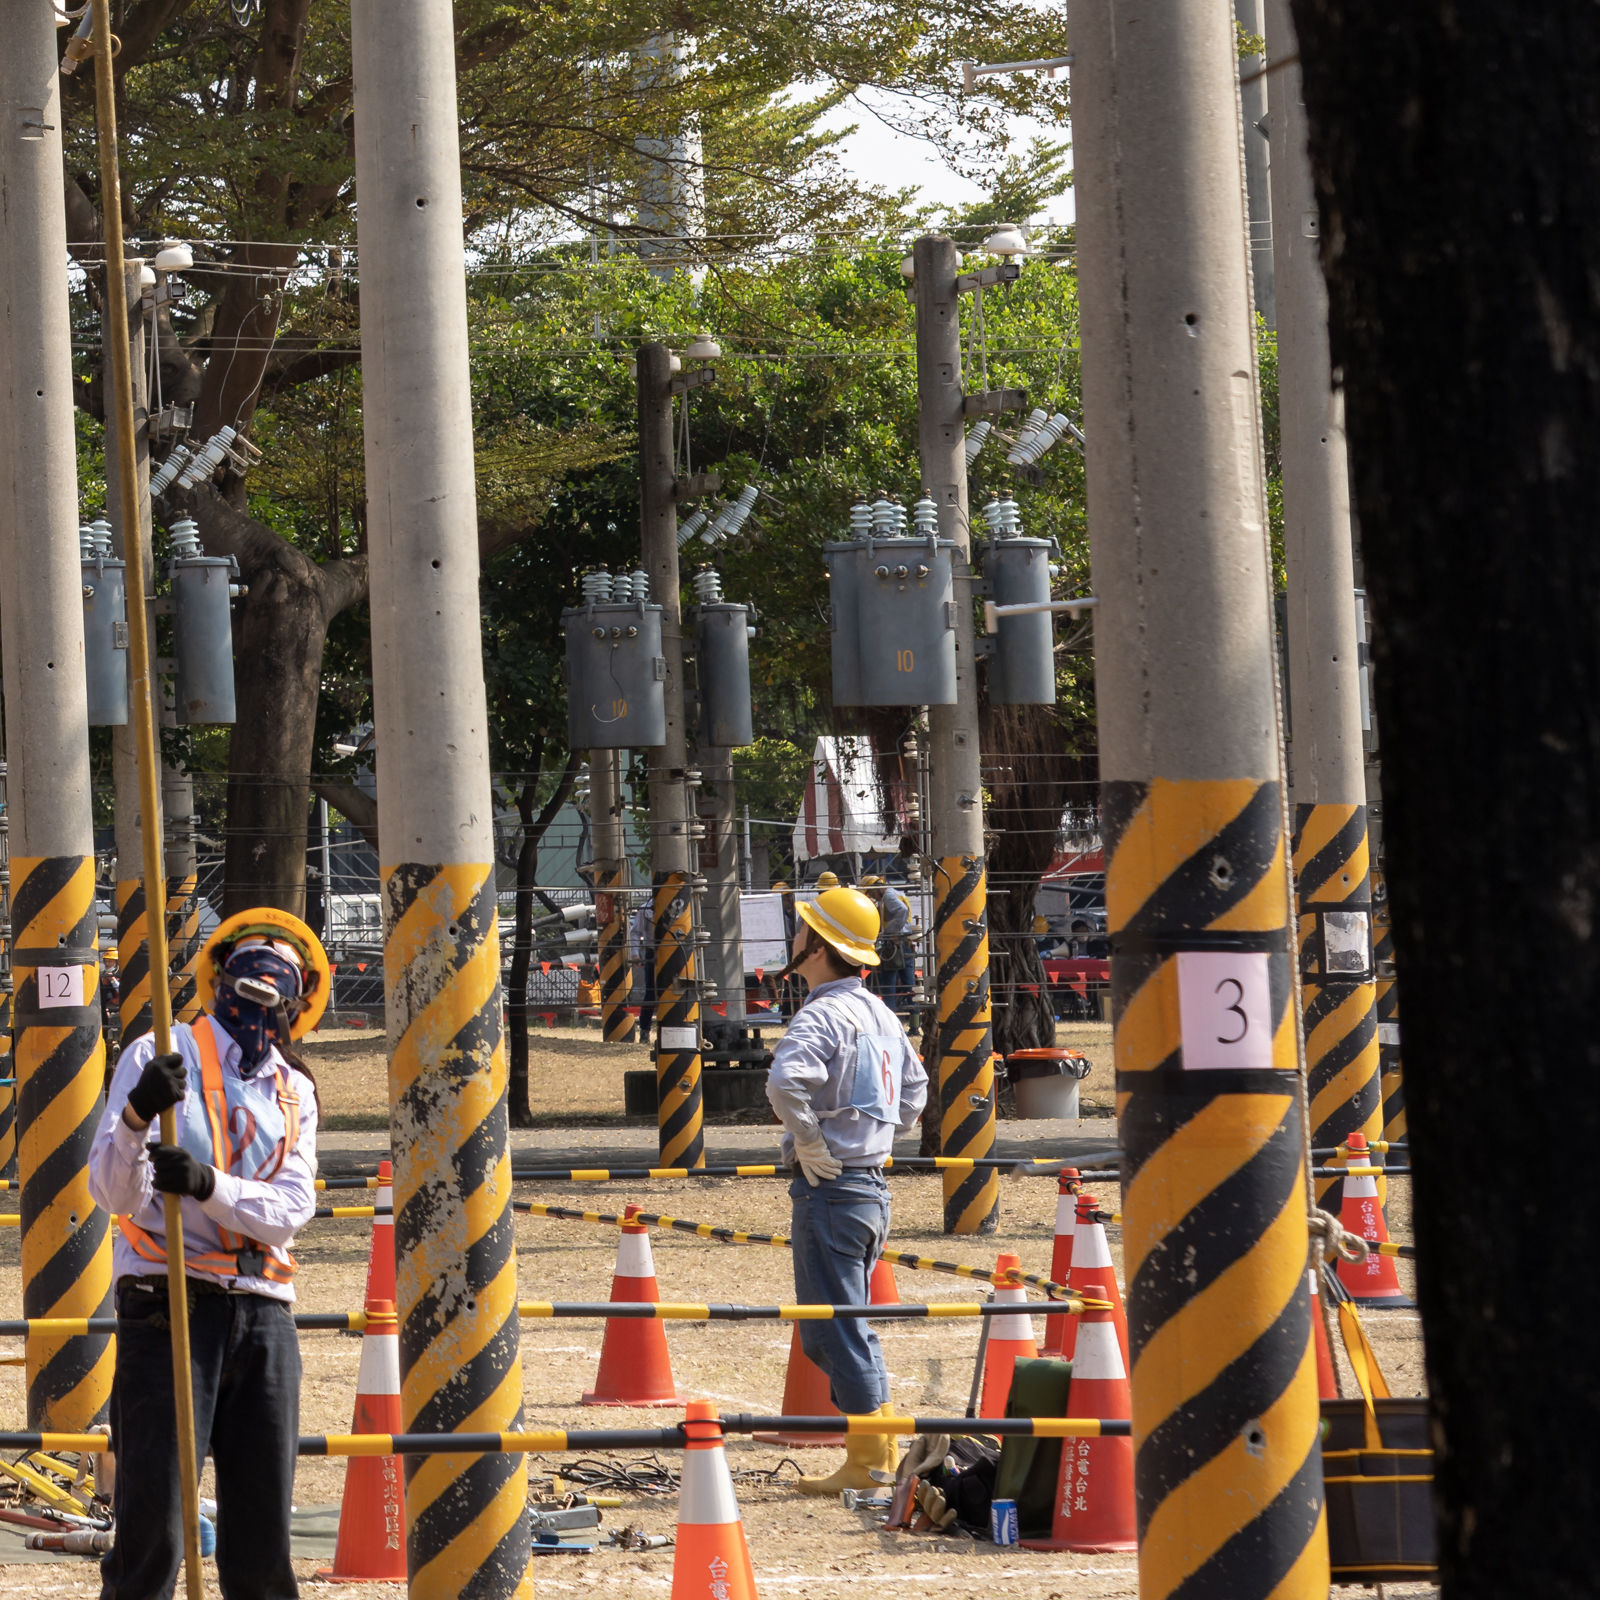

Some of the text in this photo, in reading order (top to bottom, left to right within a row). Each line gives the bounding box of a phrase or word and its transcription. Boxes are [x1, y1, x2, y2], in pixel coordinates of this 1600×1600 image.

[896, 649, 914, 672] 10
[44, 972, 73, 998] 12
[1215, 978, 1249, 1045] 3
[881, 1049, 894, 1107] 6
[1075, 1440, 1090, 1511] 台電台北
